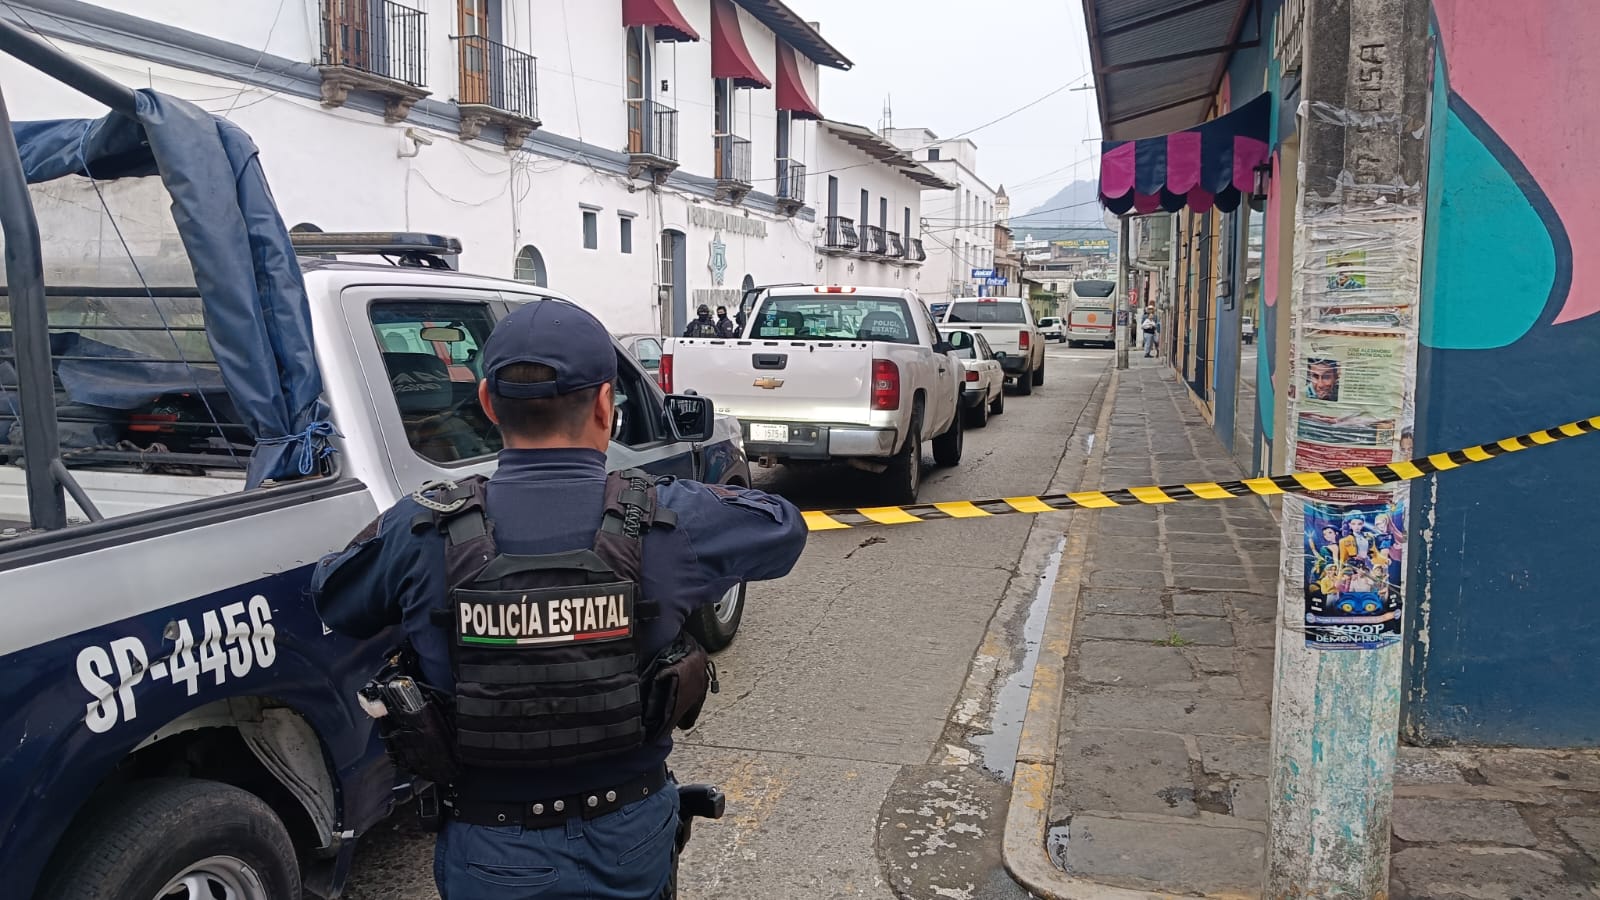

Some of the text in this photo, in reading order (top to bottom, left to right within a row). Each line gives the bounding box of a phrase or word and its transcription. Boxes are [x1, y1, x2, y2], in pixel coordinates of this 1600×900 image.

[460, 594, 629, 636] POLICÍA ESTATAL
[76, 594, 276, 734] SP-4456
